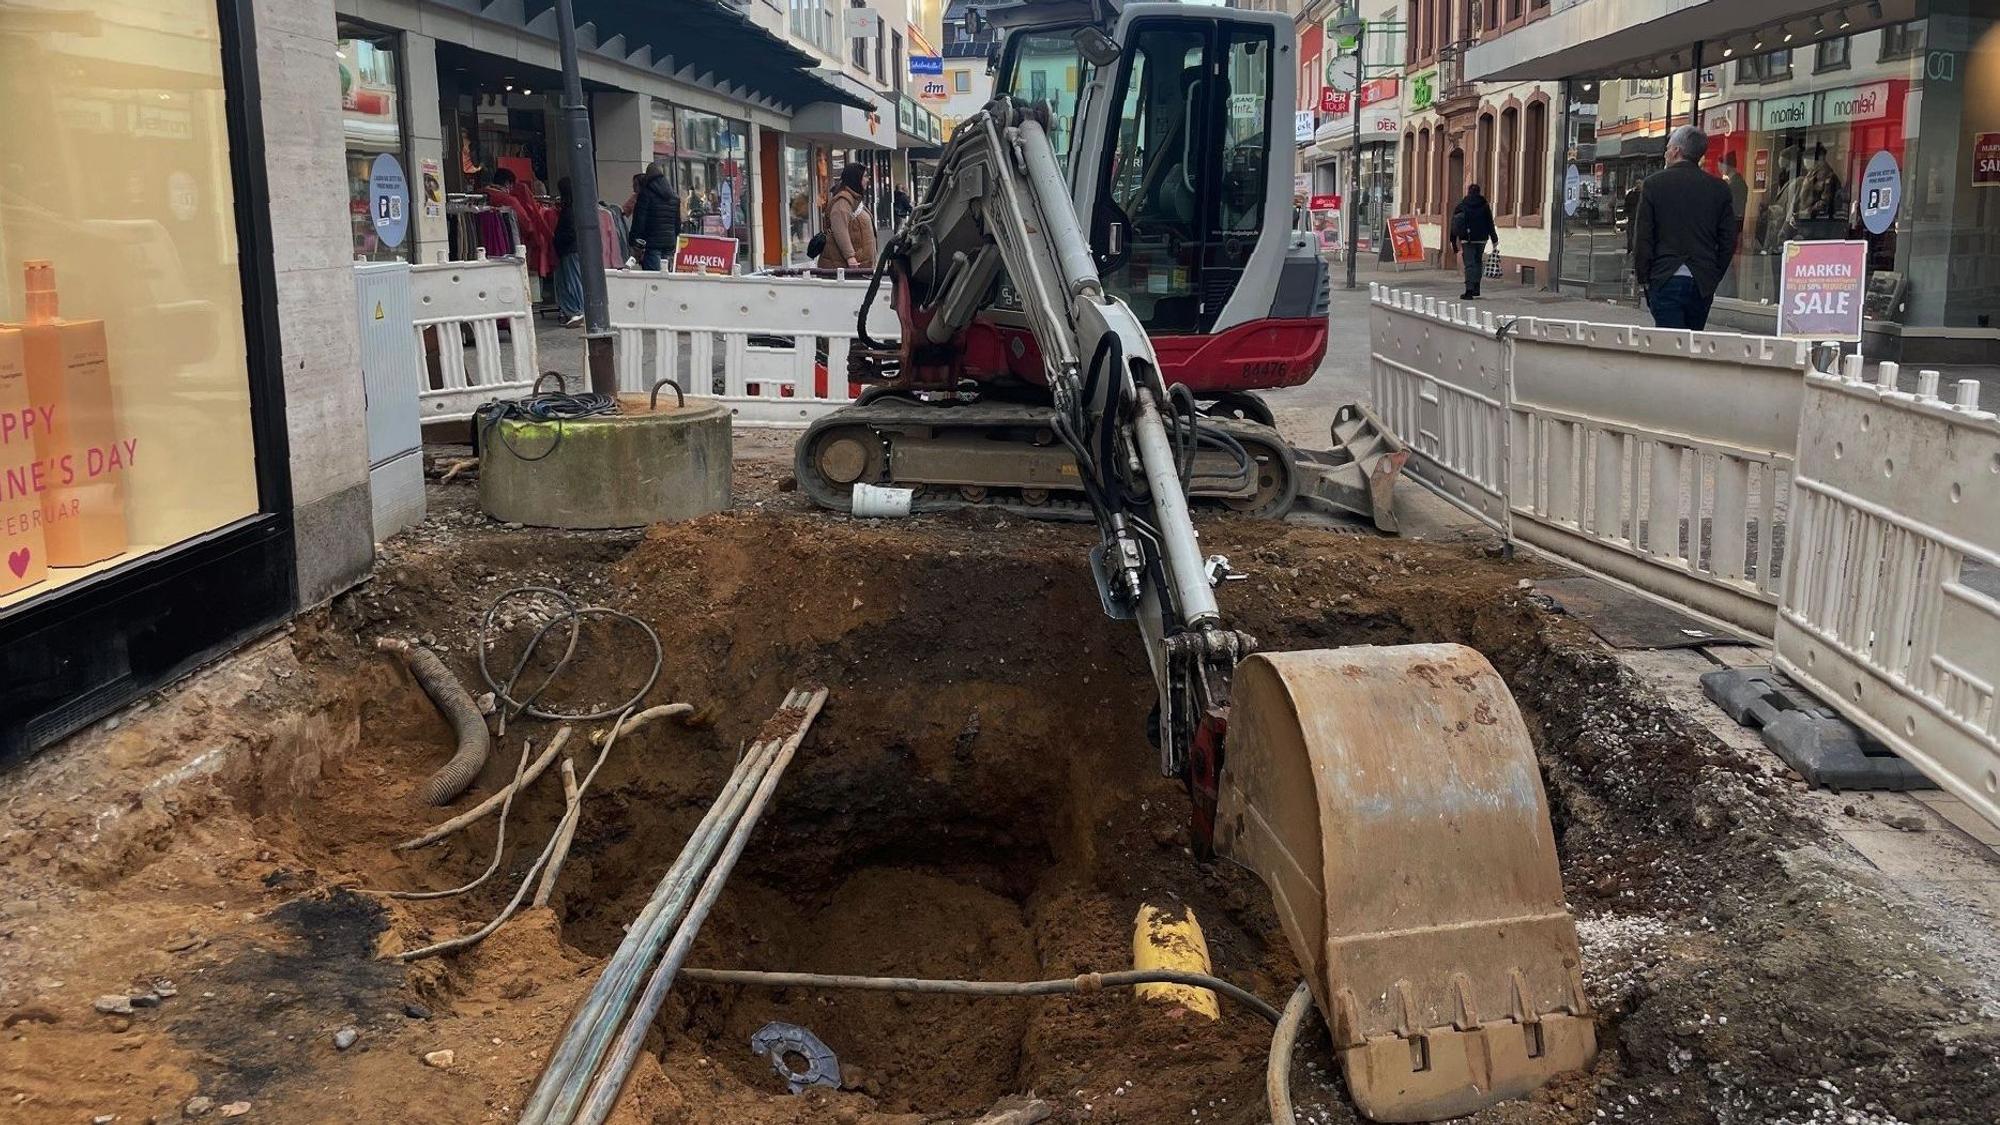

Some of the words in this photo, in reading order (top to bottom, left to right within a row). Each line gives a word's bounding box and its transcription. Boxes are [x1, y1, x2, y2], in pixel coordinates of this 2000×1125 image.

[924, 82, 944, 93] dm
[1326, 92, 1346, 102] DER
[1325, 102, 1346, 110] TOUR
[1377, 120, 1397, 131] DER
[683, 255, 725, 267] MARKEN
[1795, 264, 1851, 277] MARKEN
[1793, 291, 1850, 315] SALE
[87, 438, 138, 477] DAY
